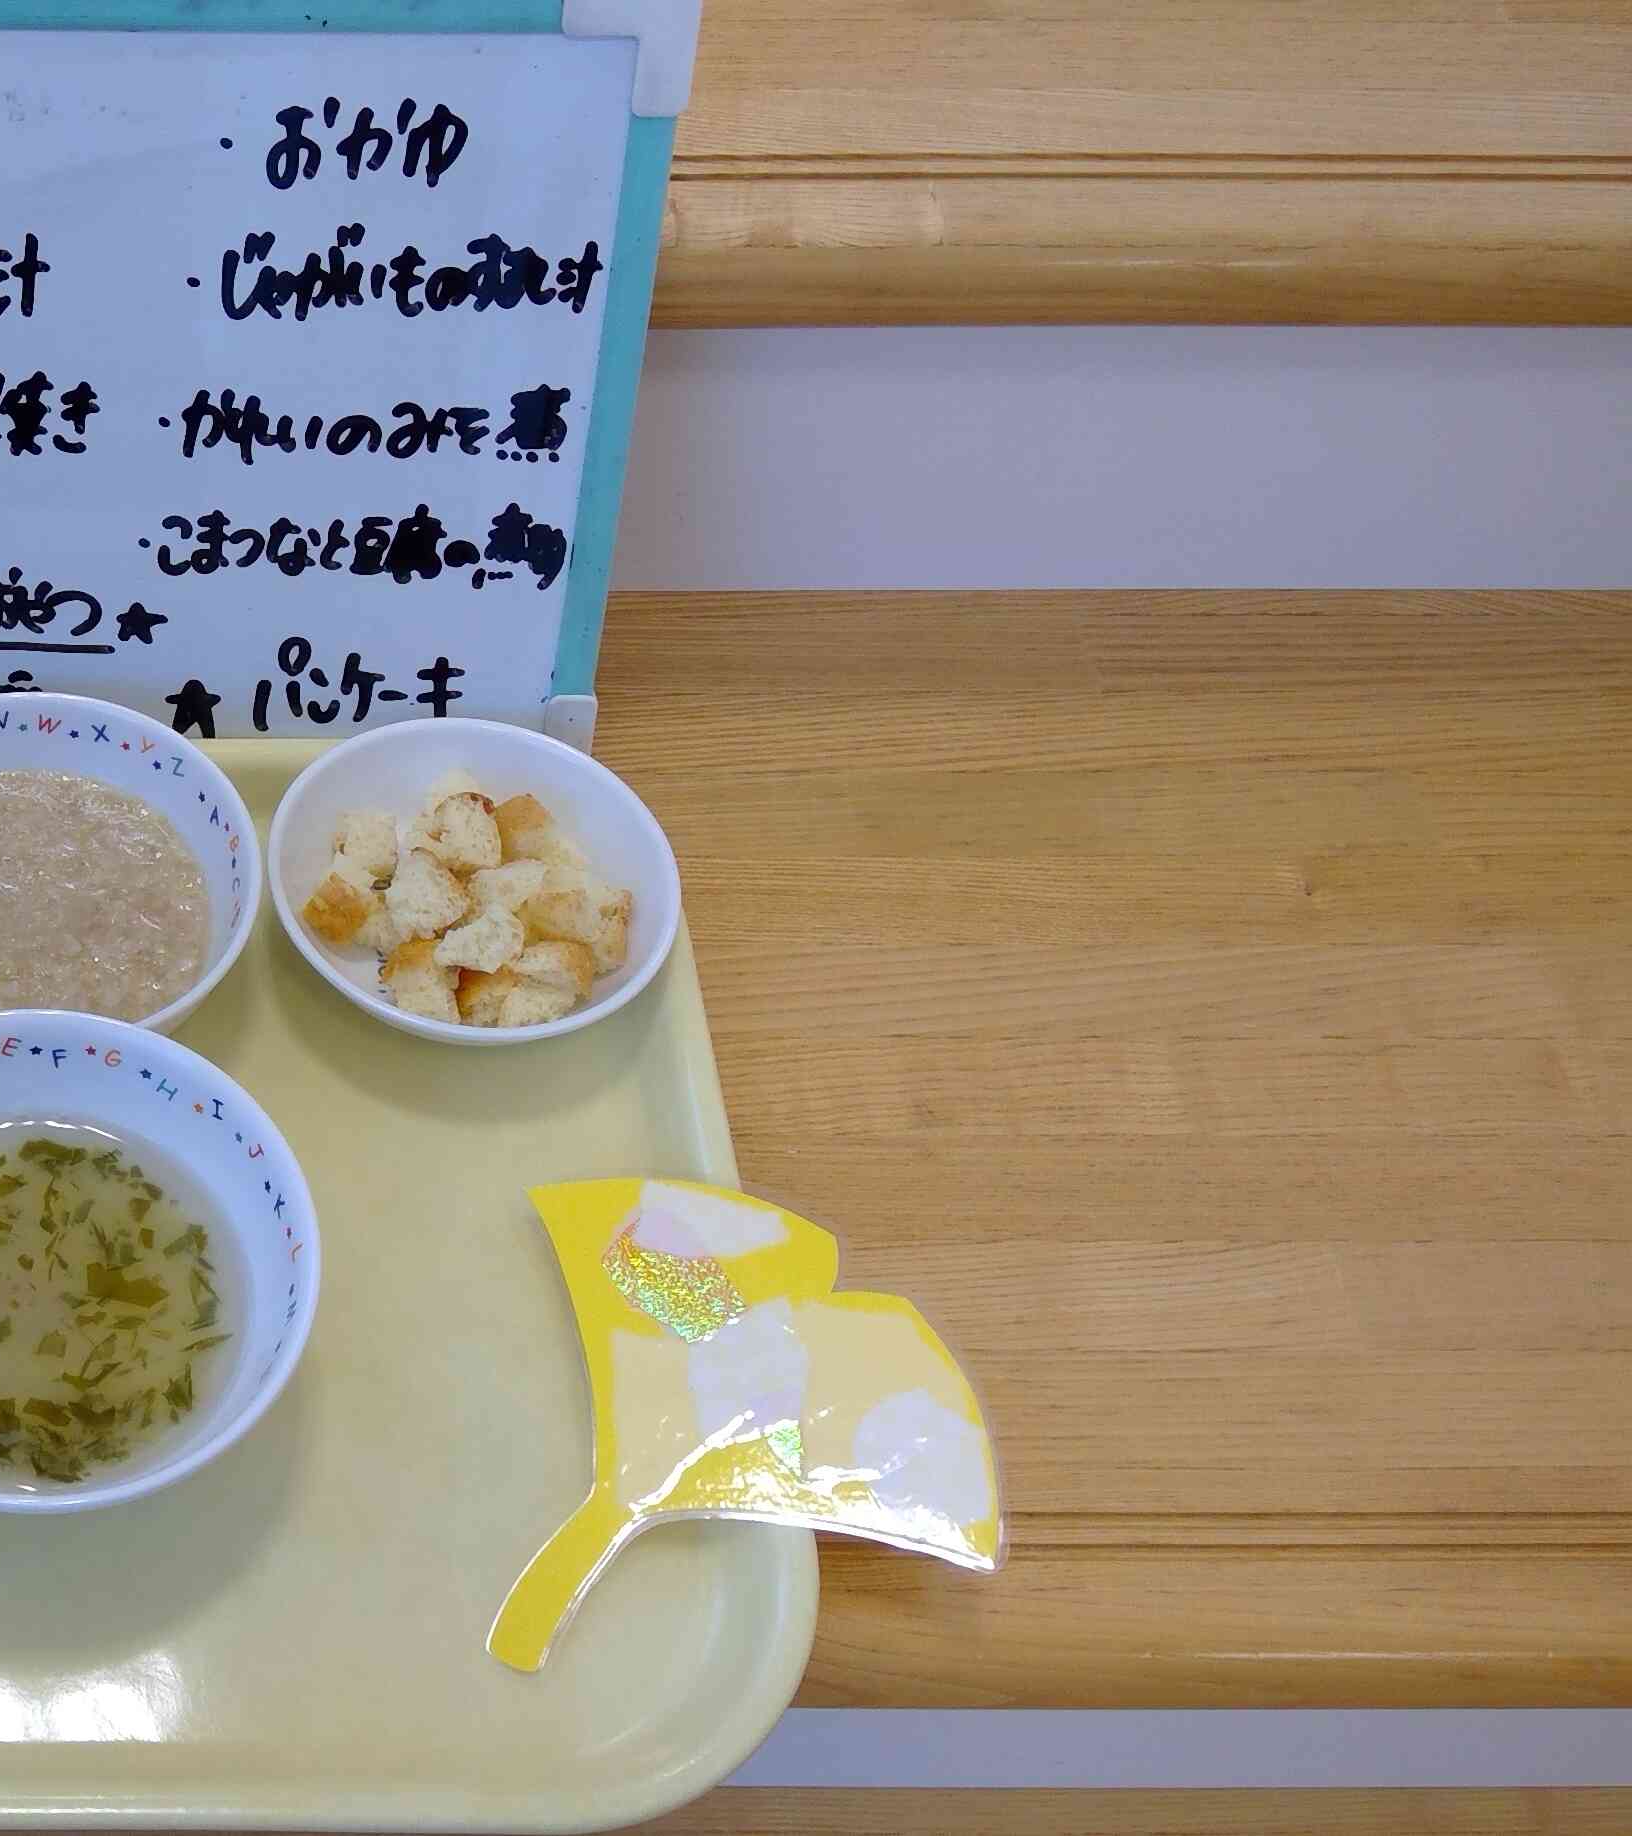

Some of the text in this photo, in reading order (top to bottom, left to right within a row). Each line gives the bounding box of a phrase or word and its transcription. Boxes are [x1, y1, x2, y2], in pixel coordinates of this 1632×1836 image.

[265, 96, 469, 190] おかゆ
[38, 713, 62, 735] W
[91, 724, 111, 743] X
[140, 735, 156, 754] Y
[170, 756, 185, 778] Z
[209, 805, 220, 826] A
[0, 1037, 23, 1057] E
[51, 1048, 67, 1069] F
[104, 1049, 122, 1068] G
[155, 1077, 179, 1102] H
[211, 1098, 225, 1121] I
[248, 1143, 265, 1159] J
[273, 1193, 286, 1220] K
